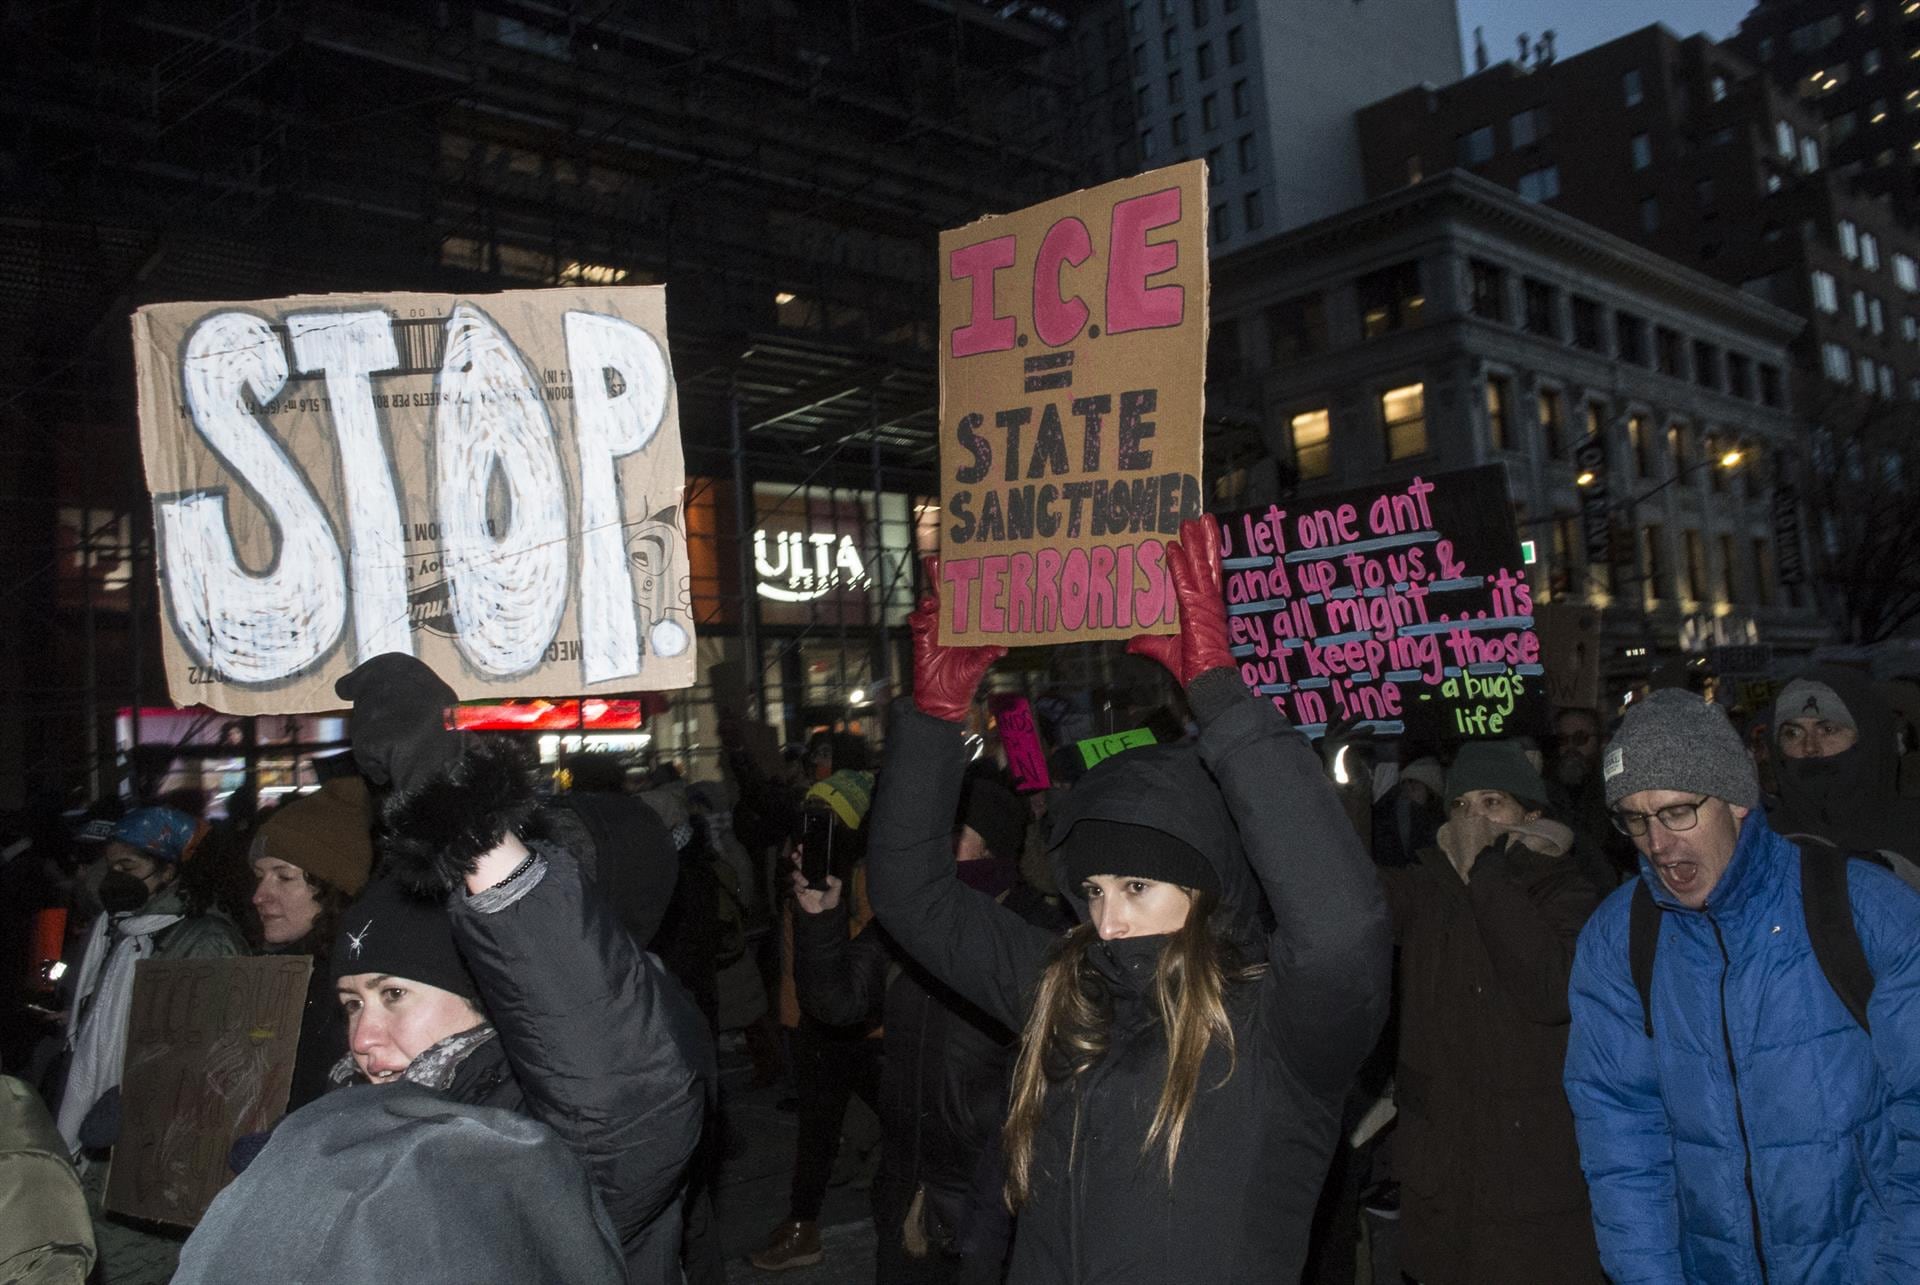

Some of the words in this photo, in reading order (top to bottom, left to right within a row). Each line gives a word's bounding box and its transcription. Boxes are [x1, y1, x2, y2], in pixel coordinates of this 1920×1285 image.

[299, 399, 319, 412] 51.6
[956, 388, 1157, 485] STATE
[948, 473, 1201, 544] SANCTIONED
[1243, 503, 1287, 557] let
[1297, 503, 1360, 549] one
[1369, 476, 1435, 535] ant
[753, 528, 865, 580] ULTA
[1226, 557, 1292, 605] and
[1298, 560, 1337, 600] up
[1343, 551, 1385, 590] to
[1273, 598, 1317, 638] all
[1241, 638, 1293, 686] out
[1303, 635, 1443, 685] keeping
[1446, 627, 1540, 667] those
[1293, 684, 1327, 724] in
[1330, 679, 1402, 721] line
[1441, 677, 1460, 699] a
[1462, 667, 1525, 716] bug's
[1455, 704, 1504, 735] life
[1091, 734, 1133, 760] ICE
